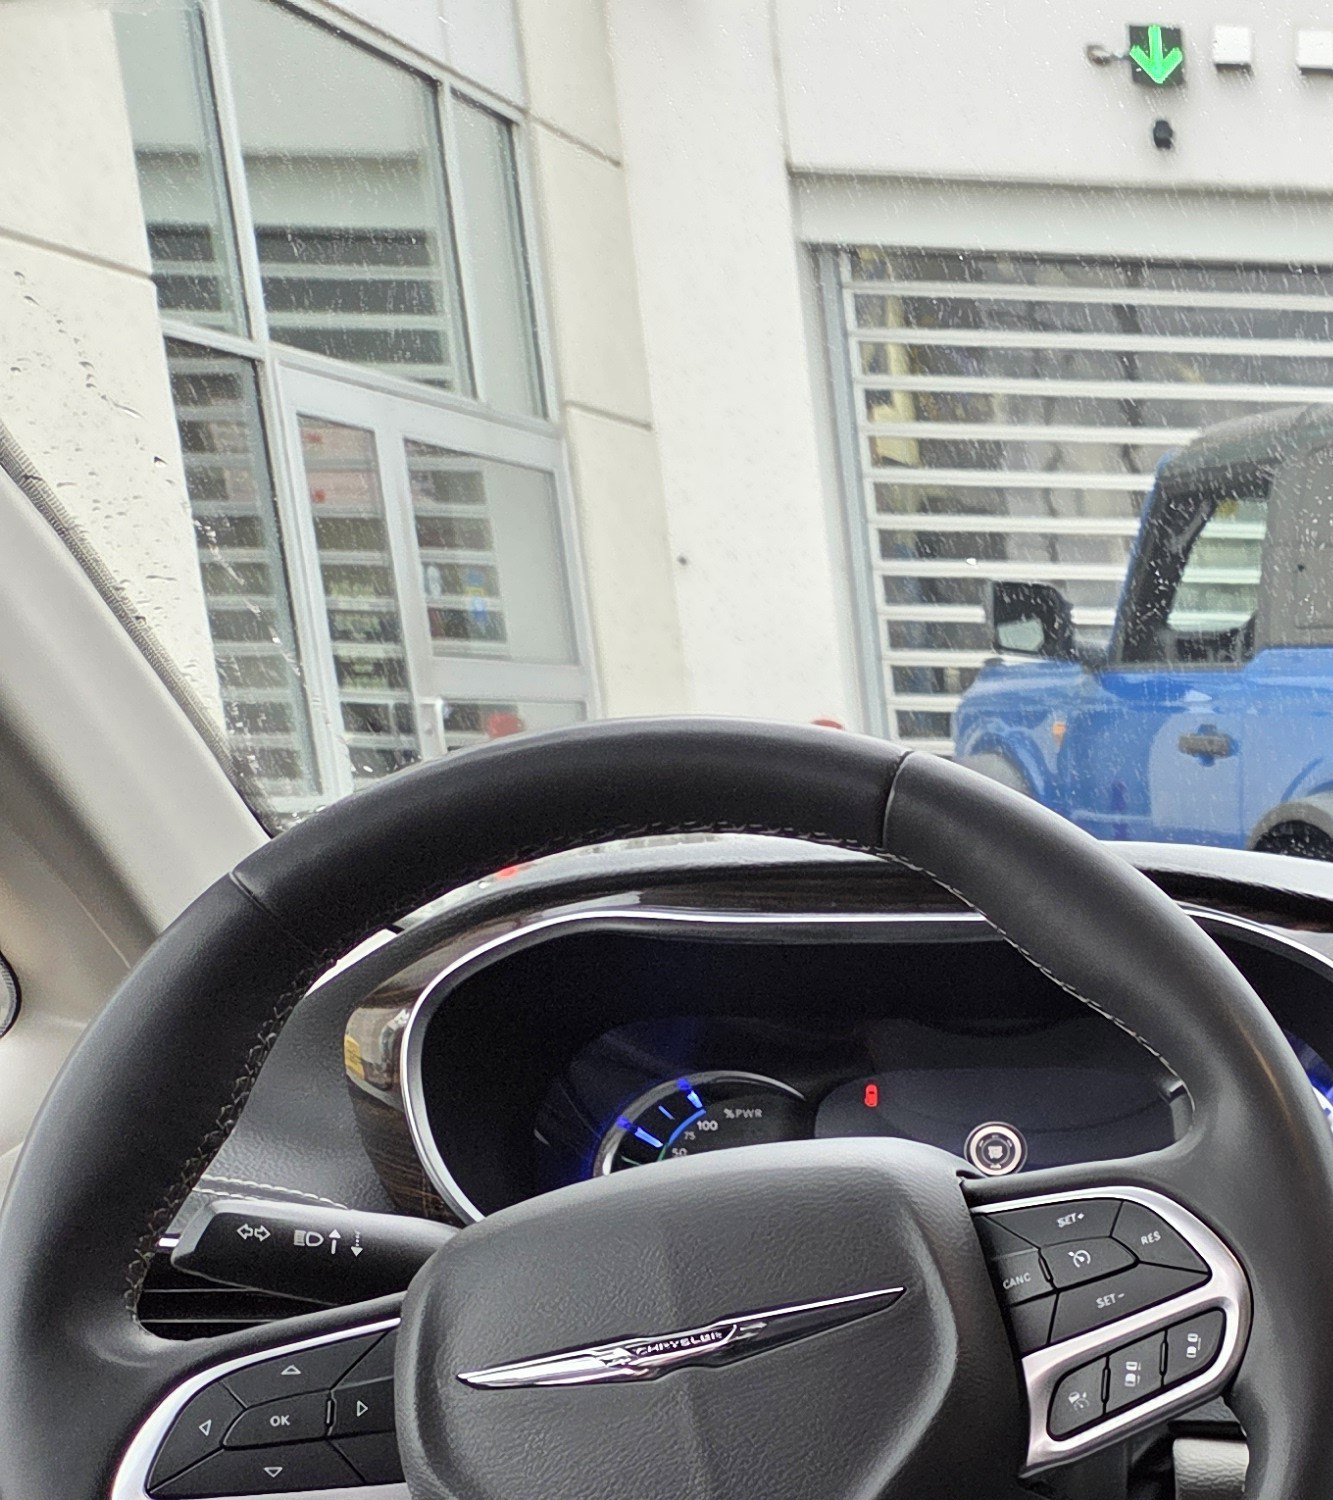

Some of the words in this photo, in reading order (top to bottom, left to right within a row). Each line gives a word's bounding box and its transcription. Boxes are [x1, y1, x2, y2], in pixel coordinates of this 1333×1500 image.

[696, 1120, 719, 1132] 100
[684, 1131, 696, 1141] 75
[1140, 1230, 1162, 1245] RES
[1002, 1272, 1032, 1290] CANC
[635, 1331, 723, 1356] CHRYSLER
[269, 1415, 291, 1427] OK
